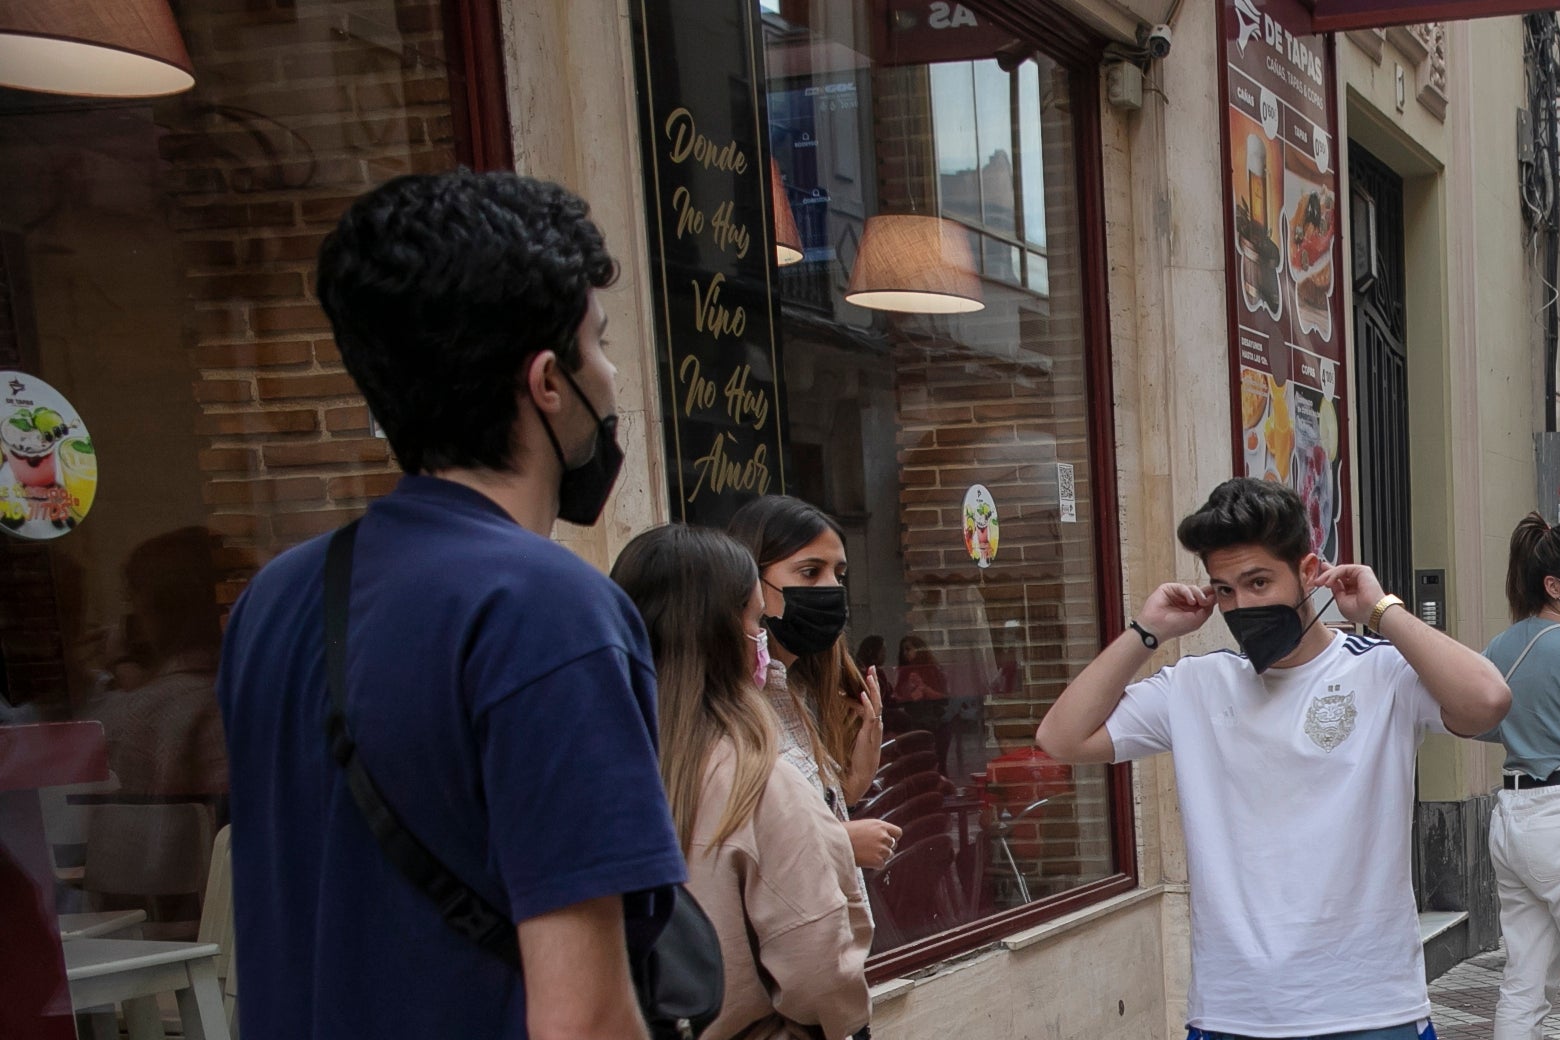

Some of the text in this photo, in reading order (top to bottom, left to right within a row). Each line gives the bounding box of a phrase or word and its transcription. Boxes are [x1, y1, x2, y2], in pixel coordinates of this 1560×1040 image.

[1264, 13, 1323, 86] DE TAPAS
[666, 107, 748, 175] Donde
[673, 186, 750, 259] No Hay
[692, 272, 745, 340] Vino
[680, 354, 768, 431] No Hay
[1301, 364, 1316, 378] COPAS
